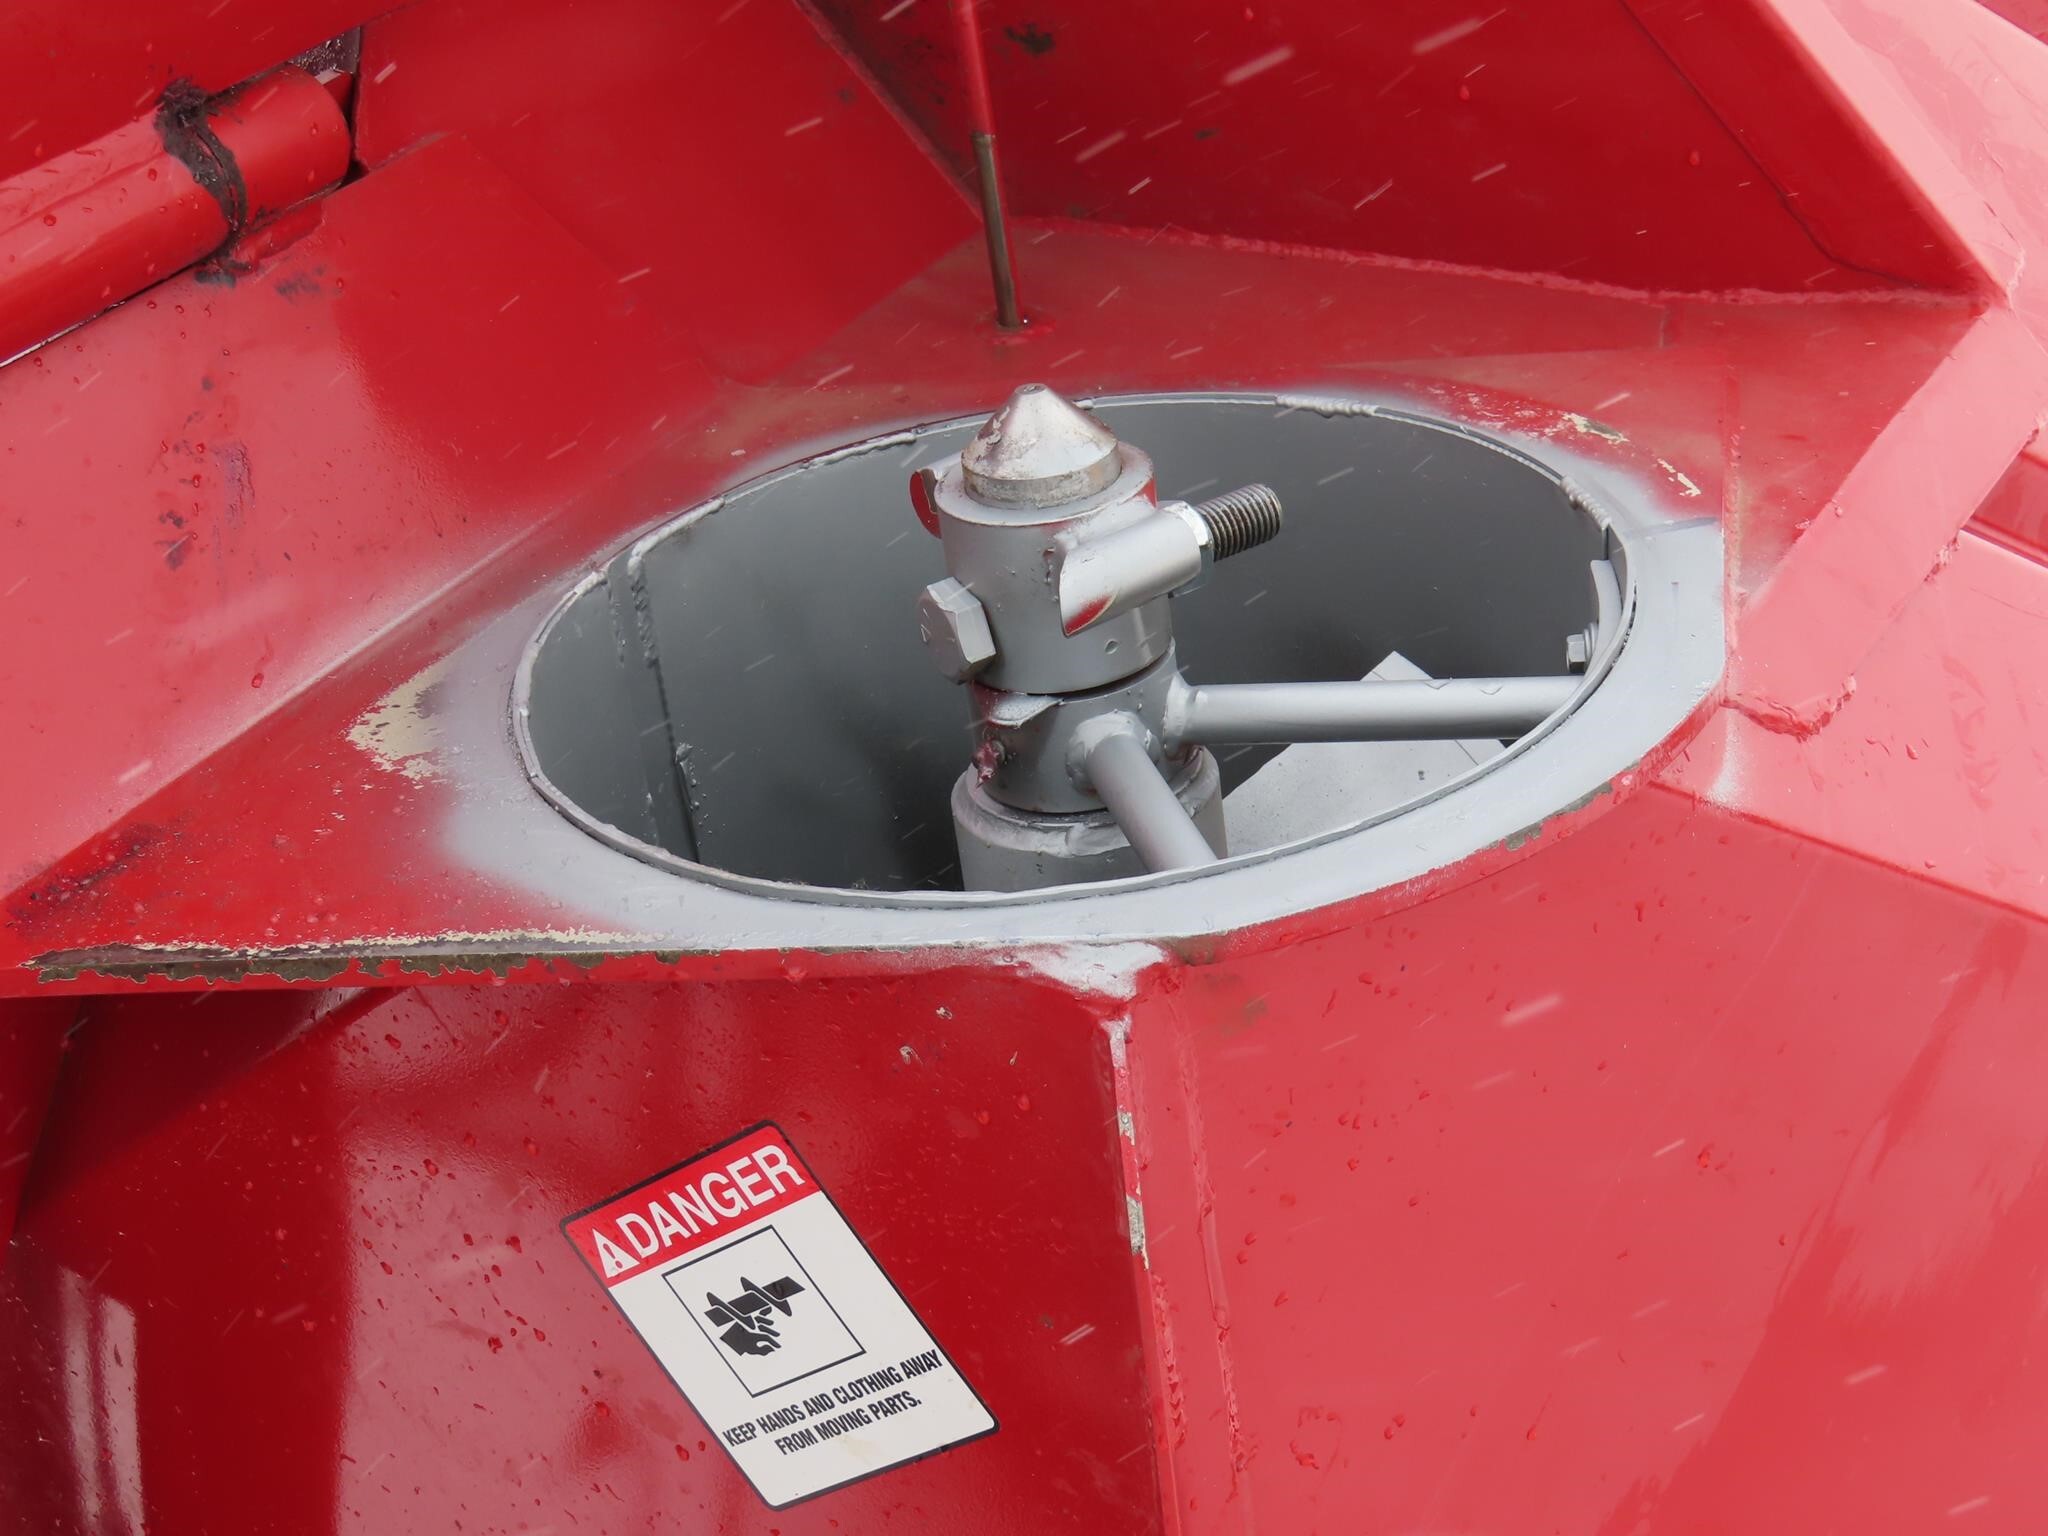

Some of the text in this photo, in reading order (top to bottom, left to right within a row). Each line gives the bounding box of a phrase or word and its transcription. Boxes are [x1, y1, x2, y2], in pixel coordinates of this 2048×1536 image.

[616, 1145, 805, 1259] DANGER
[722, 1350, 943, 1447] KEEP HANDS AND CLOTHING AWAY
[774, 1390, 922, 1455] FROM MOVING PARTS.
